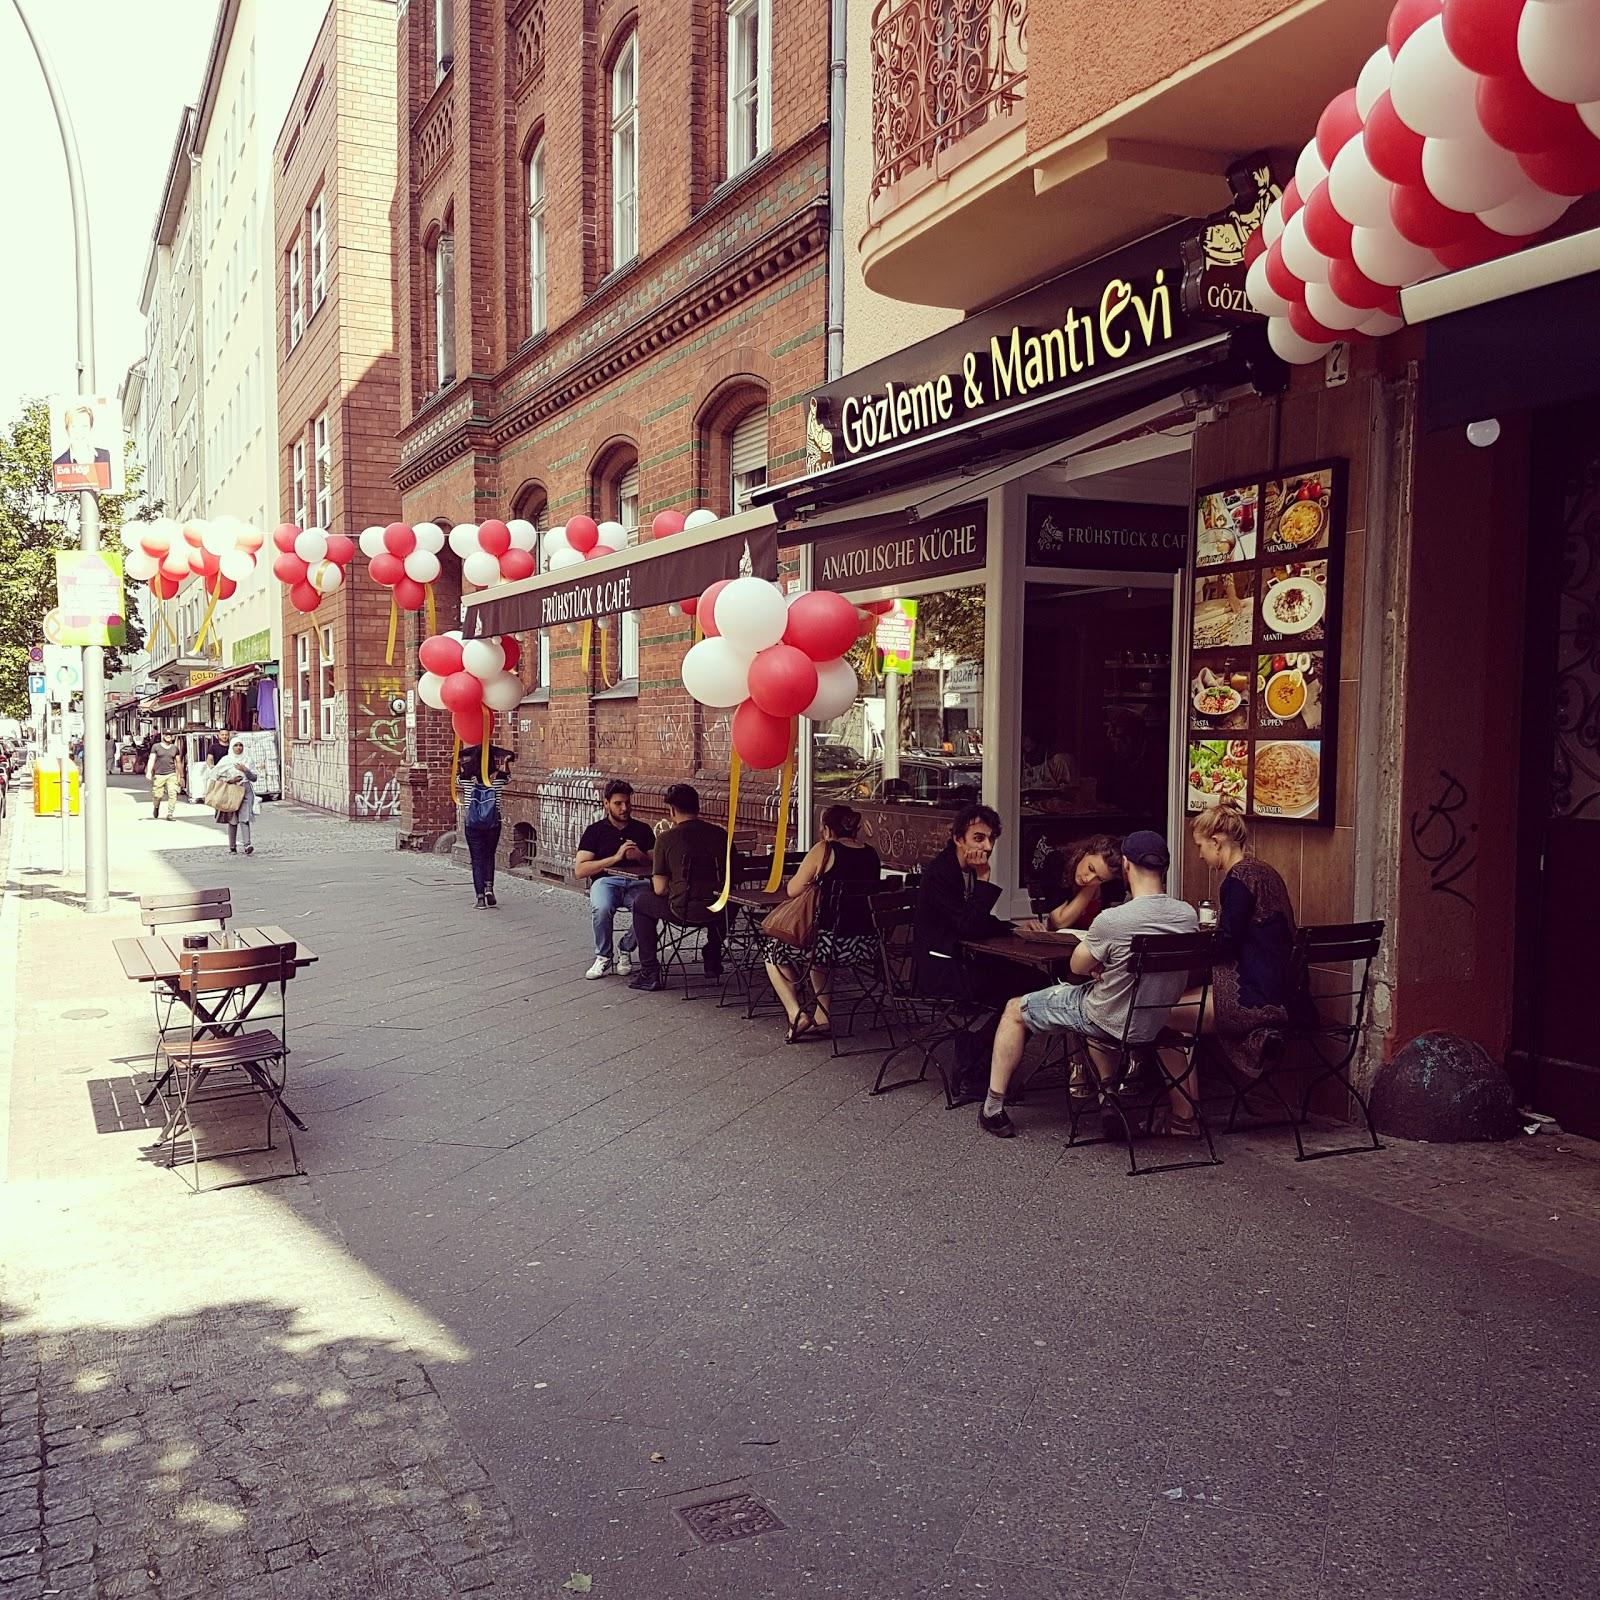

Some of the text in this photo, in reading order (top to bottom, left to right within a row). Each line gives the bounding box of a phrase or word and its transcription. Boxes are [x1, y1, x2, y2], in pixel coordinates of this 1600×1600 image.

[1207, 283, 1259, 313] GÖZL
[1330, 341, 1344, 372] 7
[842, 375, 953, 453] Gözleme
[964, 352, 985, 409] &
[821, 524, 977, 581] ANATOLISCHE KÜCHE
[1068, 526, 1187, 549] FRÜHSTÜCK & CAF
[1266, 543, 1298, 553] MENEMEN
[541, 569, 631, 624] FRÜHSTÜCK & CAFÉ
[1193, 719, 1209, 728] PASTA
[1260, 719, 1284, 728] SUPPEN
